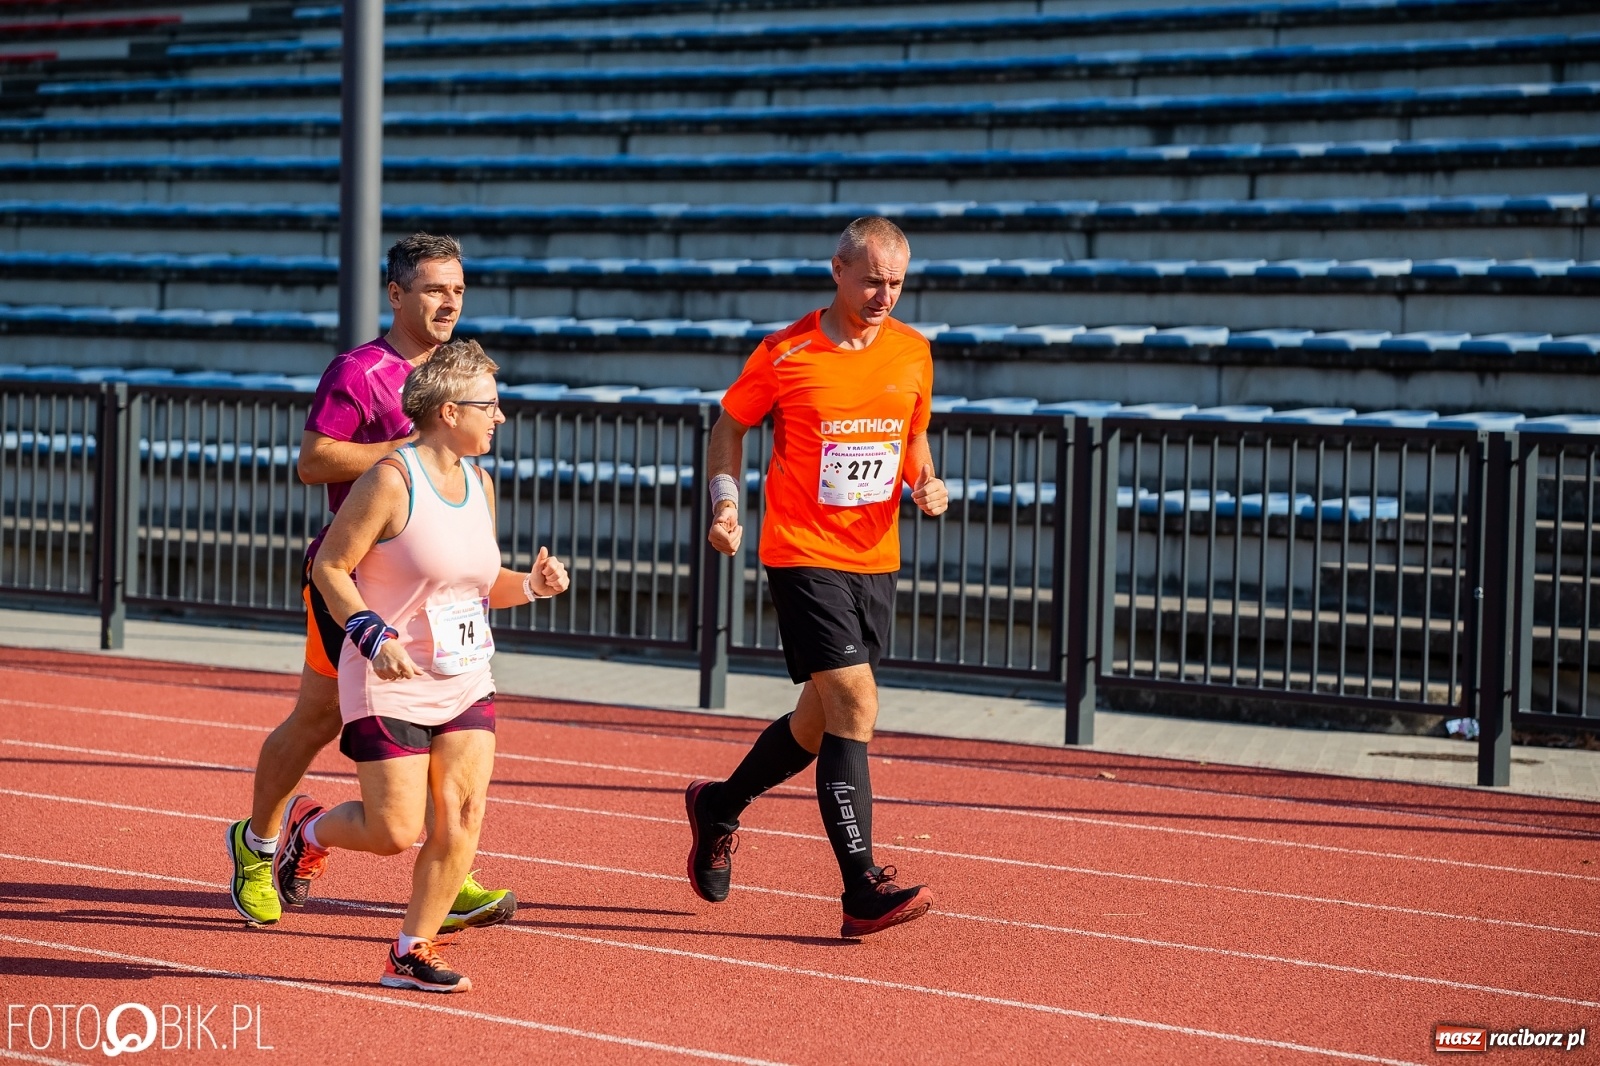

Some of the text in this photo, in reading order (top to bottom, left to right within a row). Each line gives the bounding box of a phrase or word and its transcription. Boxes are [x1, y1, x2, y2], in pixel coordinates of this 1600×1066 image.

[821, 419, 904, 435] DECATHLON
[848, 460, 883, 480] 277
[459, 621, 474, 646] 74
[826, 782, 867, 854] kalenji
